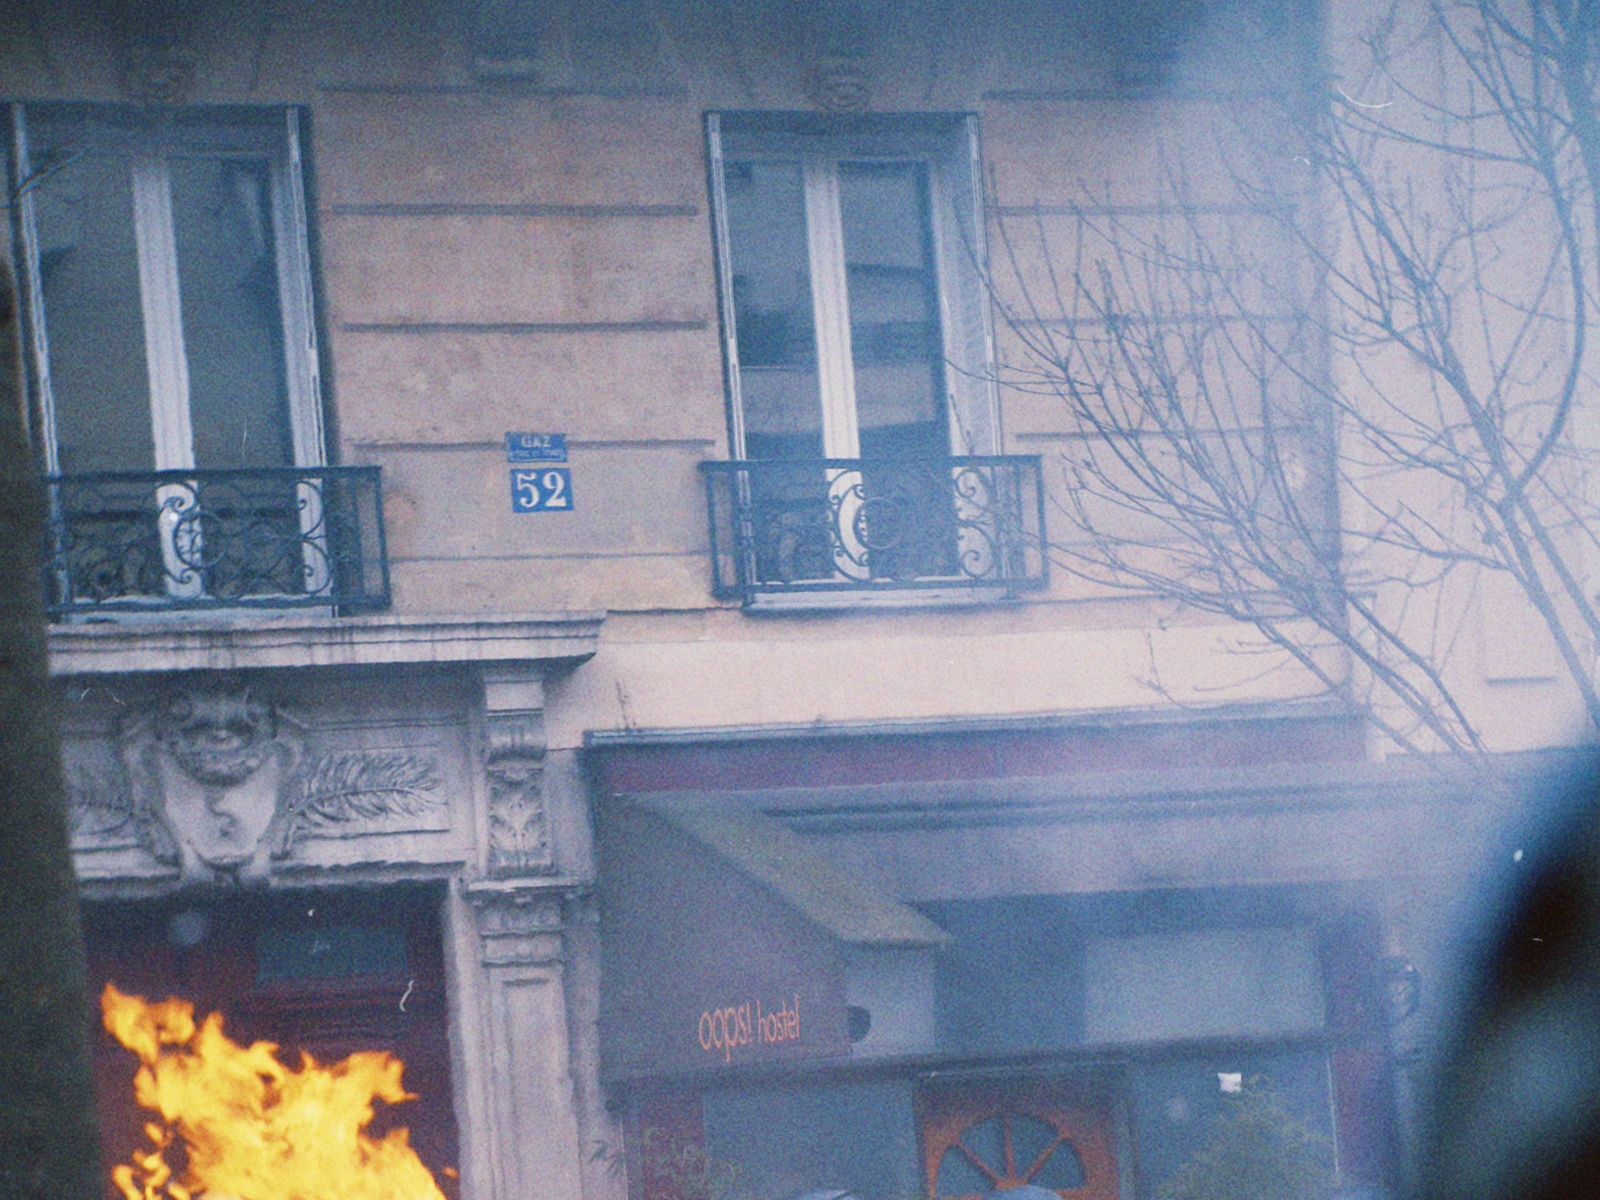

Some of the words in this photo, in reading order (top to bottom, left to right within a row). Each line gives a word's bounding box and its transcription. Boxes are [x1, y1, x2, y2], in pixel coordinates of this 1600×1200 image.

[520, 435, 552, 448] GAZ
[516, 471, 567, 508] 52
[699, 1002, 753, 1066] oops!
[756, 992, 801, 1043] hostel
